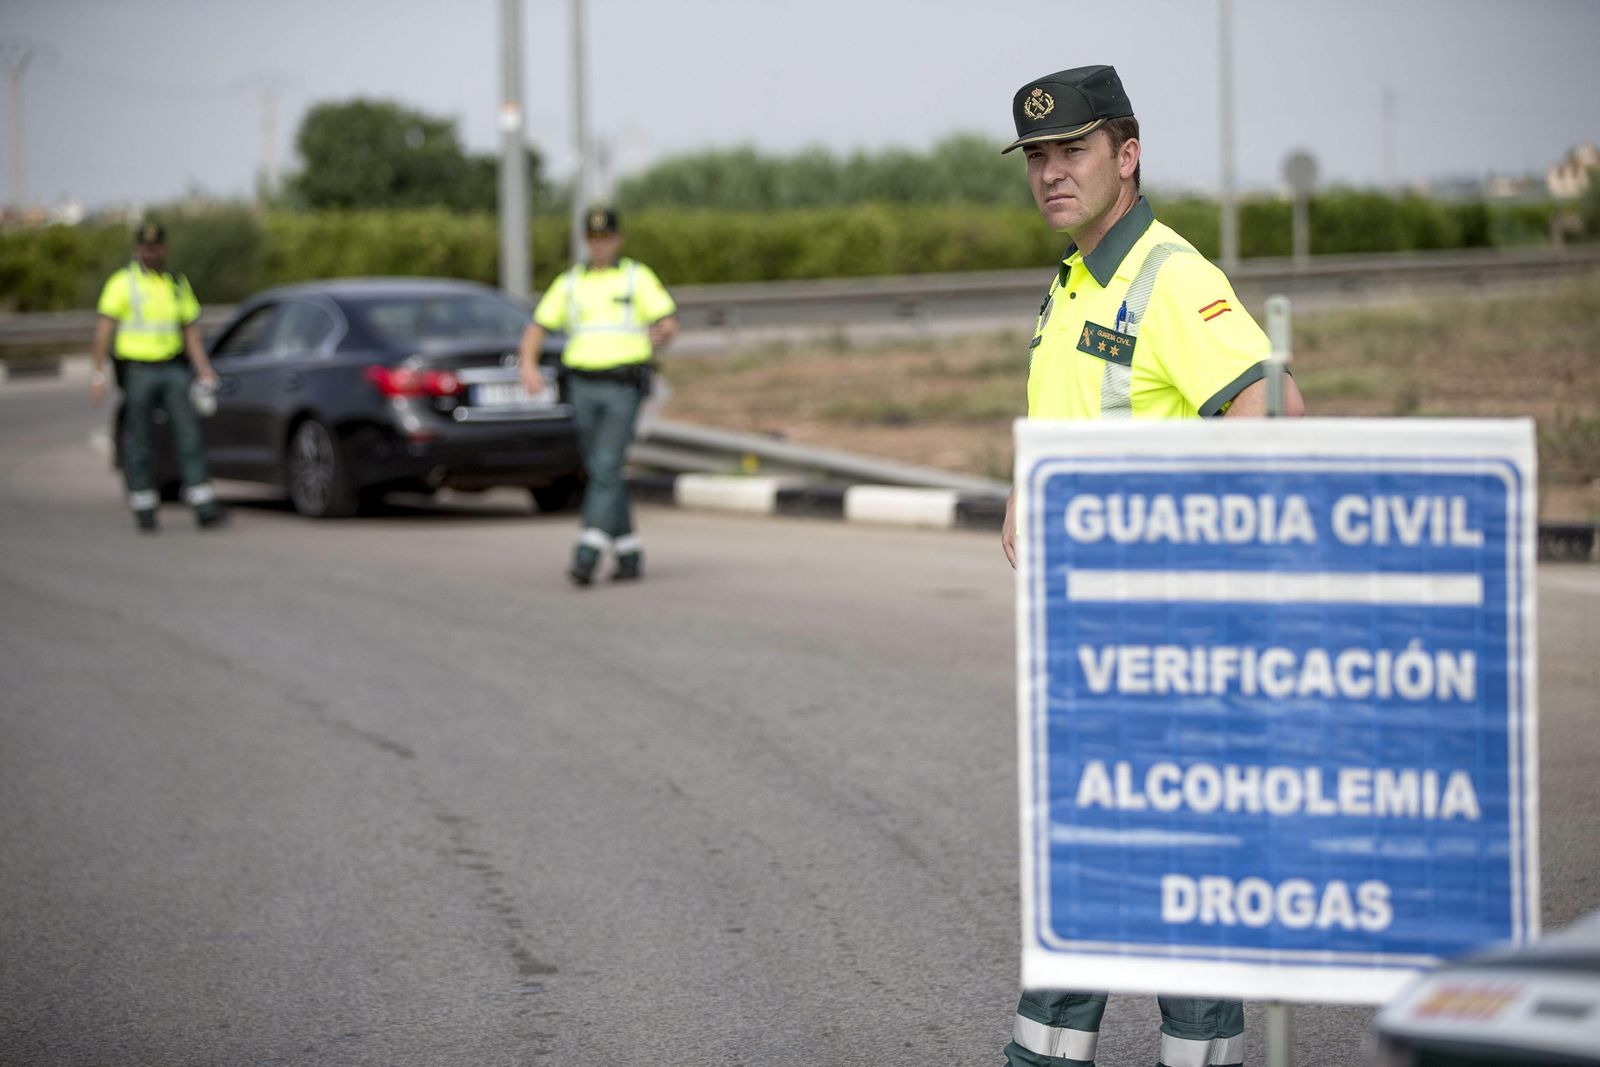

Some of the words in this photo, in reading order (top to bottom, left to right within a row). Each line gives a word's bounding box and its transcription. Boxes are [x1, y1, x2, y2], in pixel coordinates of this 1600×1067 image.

[1116, 337, 1131, 346] CIVIL
[1064, 494, 1317, 544] GUARDIA
[1331, 496, 1484, 548] CIVIL
[1079, 638, 1476, 700] VERIFICACIÓN
[1076, 761, 1480, 820] ALCOHOLEMIA
[1161, 874, 1392, 931] DROGAS
